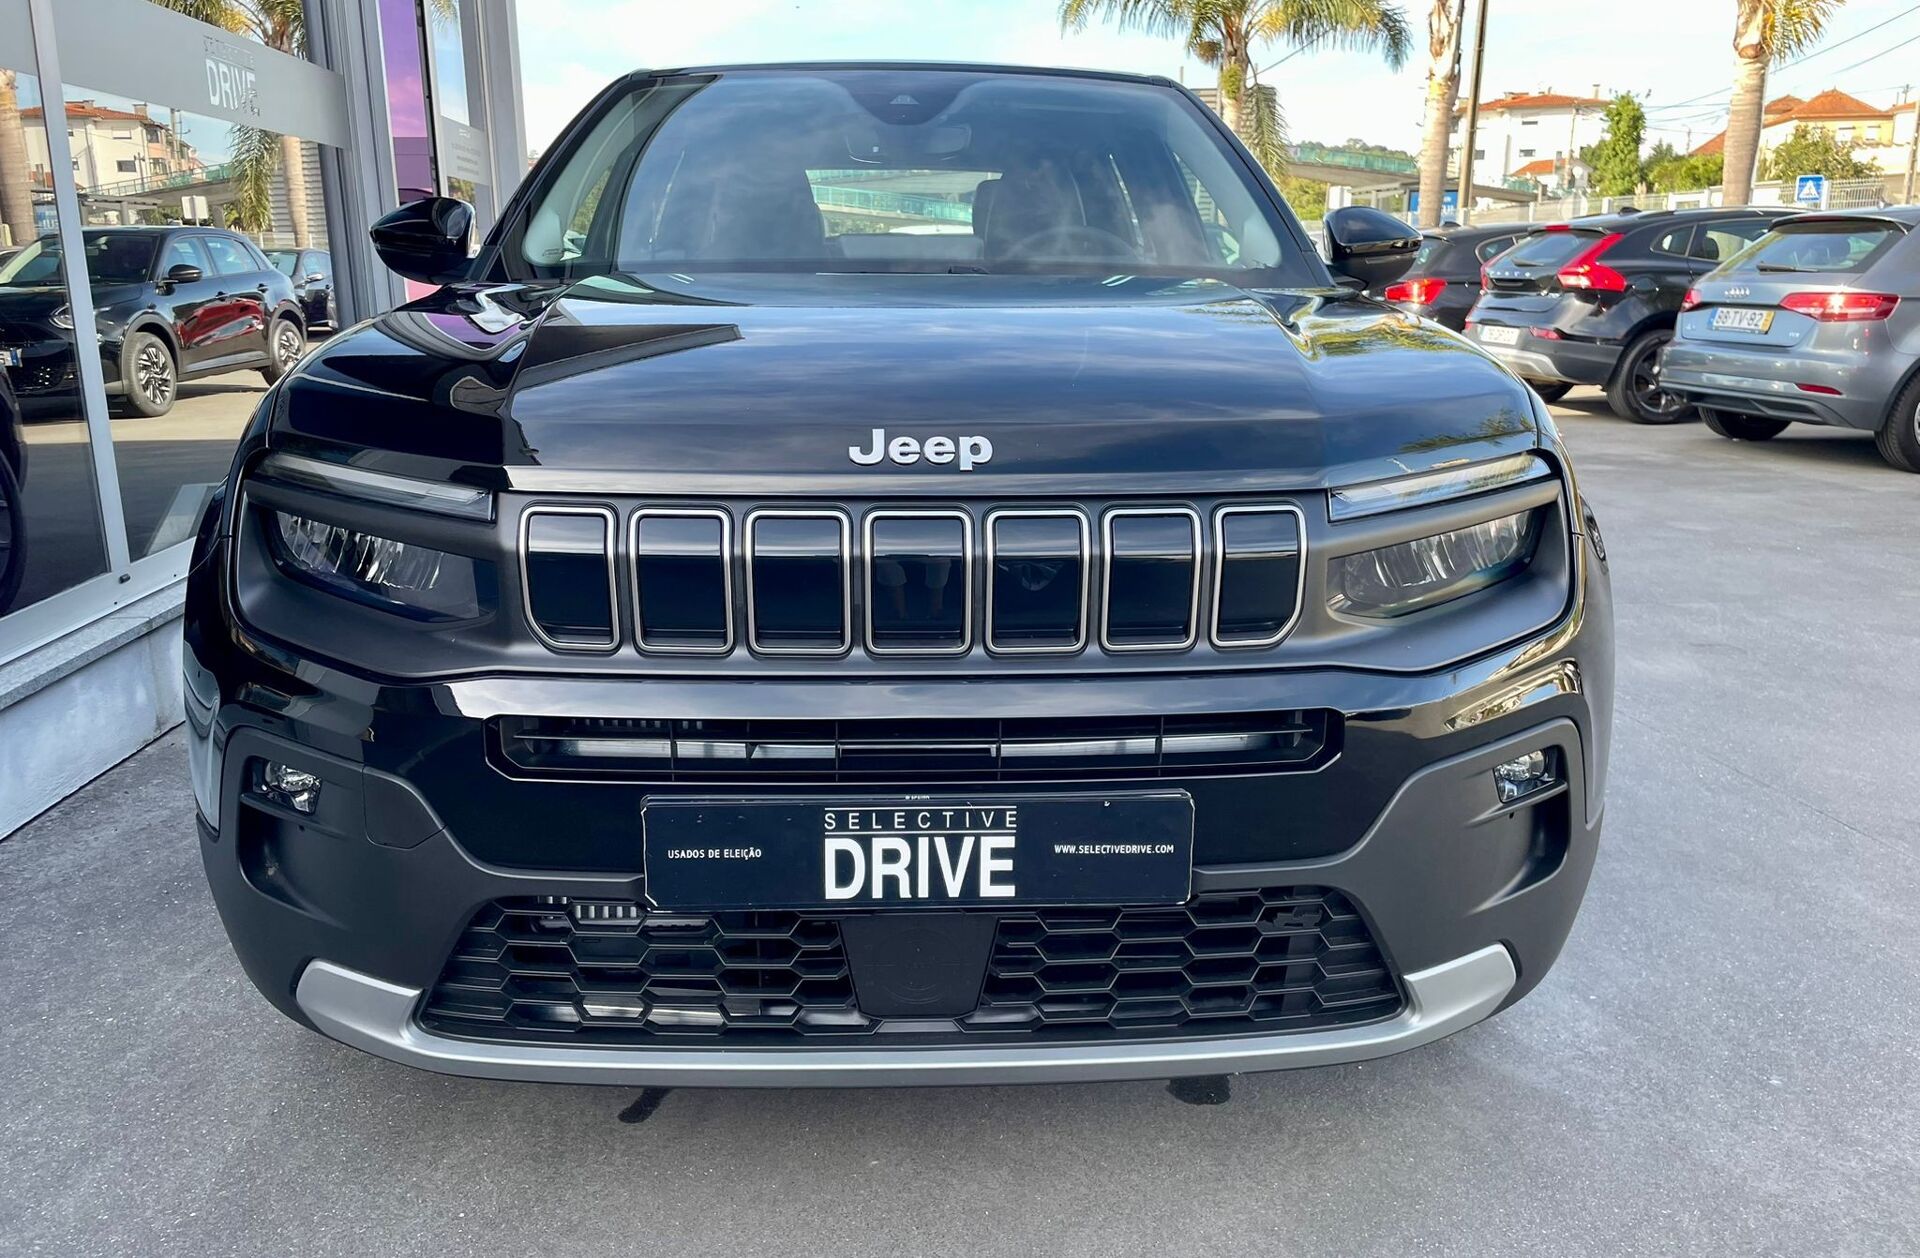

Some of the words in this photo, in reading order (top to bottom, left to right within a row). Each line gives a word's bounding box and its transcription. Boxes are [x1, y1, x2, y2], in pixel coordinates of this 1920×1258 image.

[848, 428, 994, 472] Jeep
[824, 811, 1017, 830] SELECTIVE
[667, 849, 705, 859] USADOS
[708, 848, 721, 859] DE
[723, 846, 762, 861] ELEIÇÃO
[1054, 844, 1175, 855] WWW.SELECTIVEDRIVE.COM
[824, 835, 1016, 900] DRIVE
